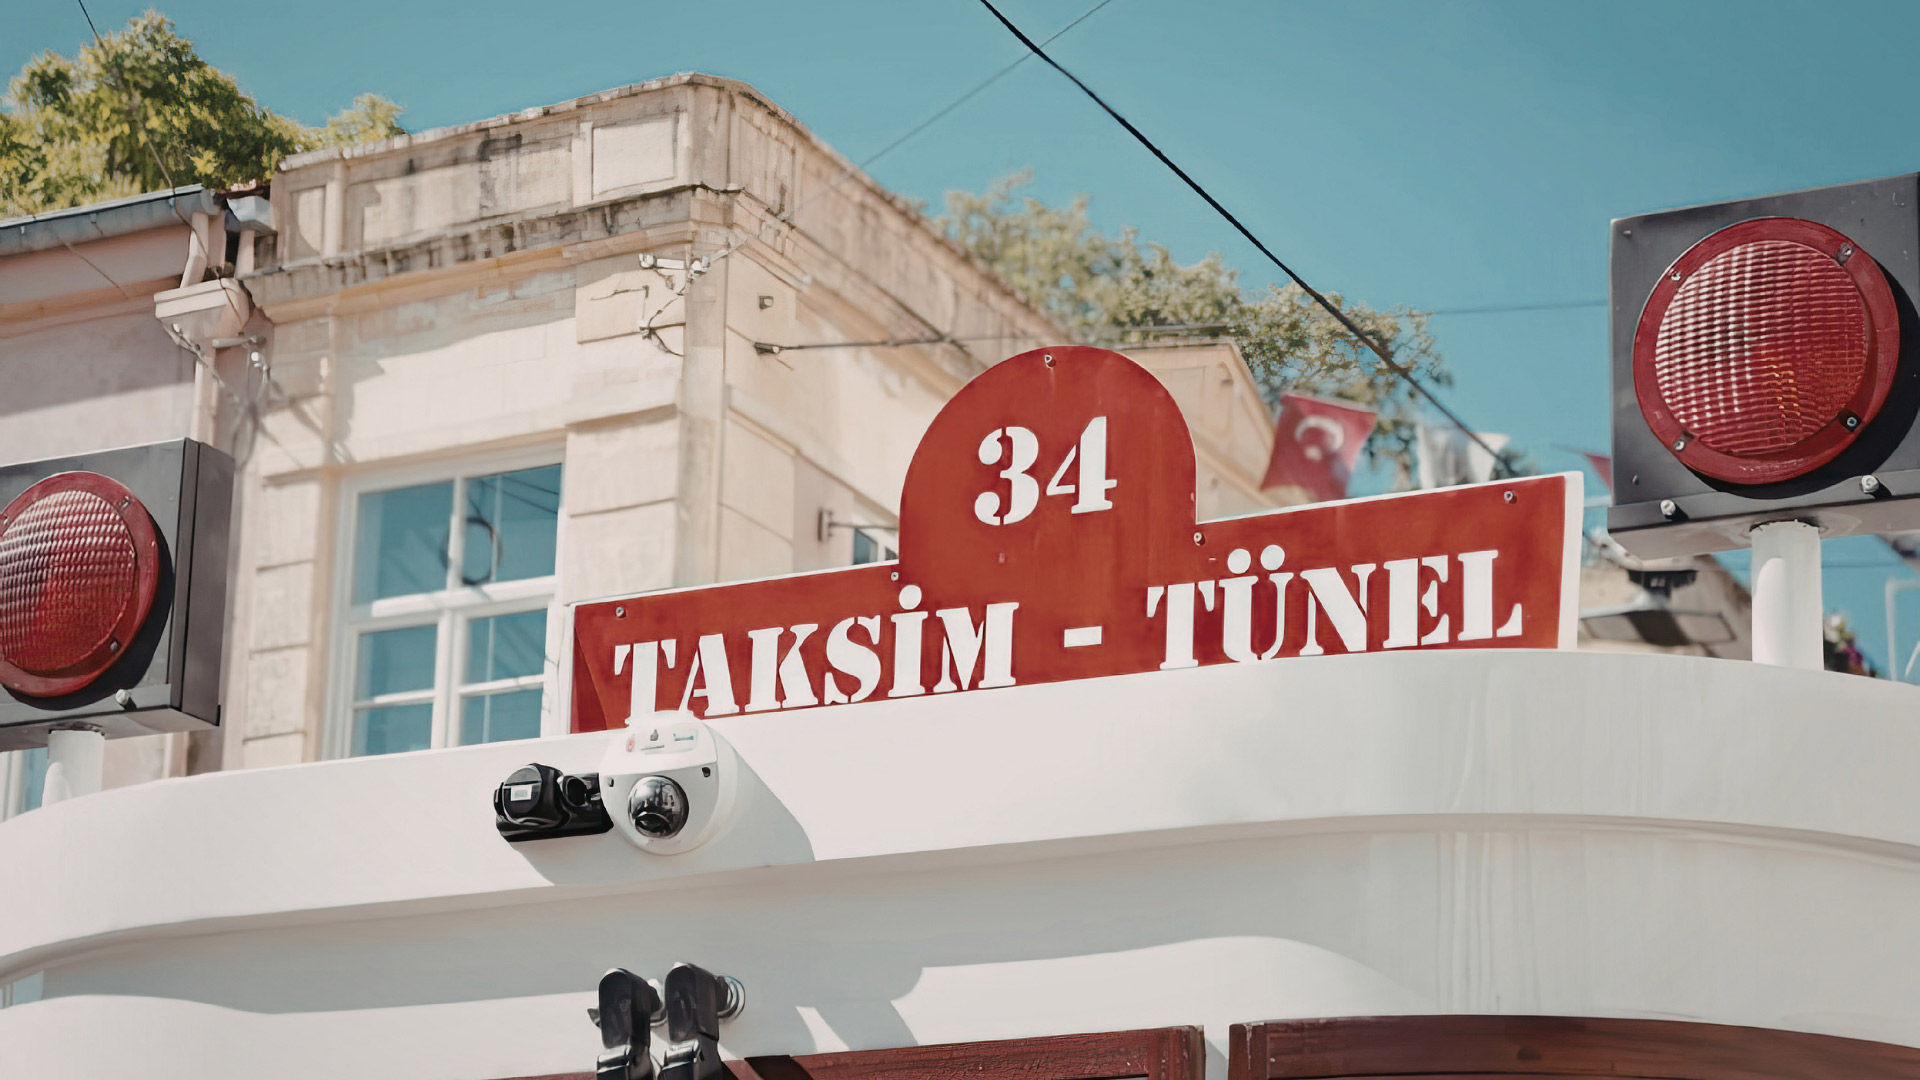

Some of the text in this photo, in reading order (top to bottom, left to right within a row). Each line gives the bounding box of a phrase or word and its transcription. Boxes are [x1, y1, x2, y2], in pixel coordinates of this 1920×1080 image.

[974, 416, 1117, 526] 34
[614, 544, 1523, 725] TAKSİM - TÜNEL
